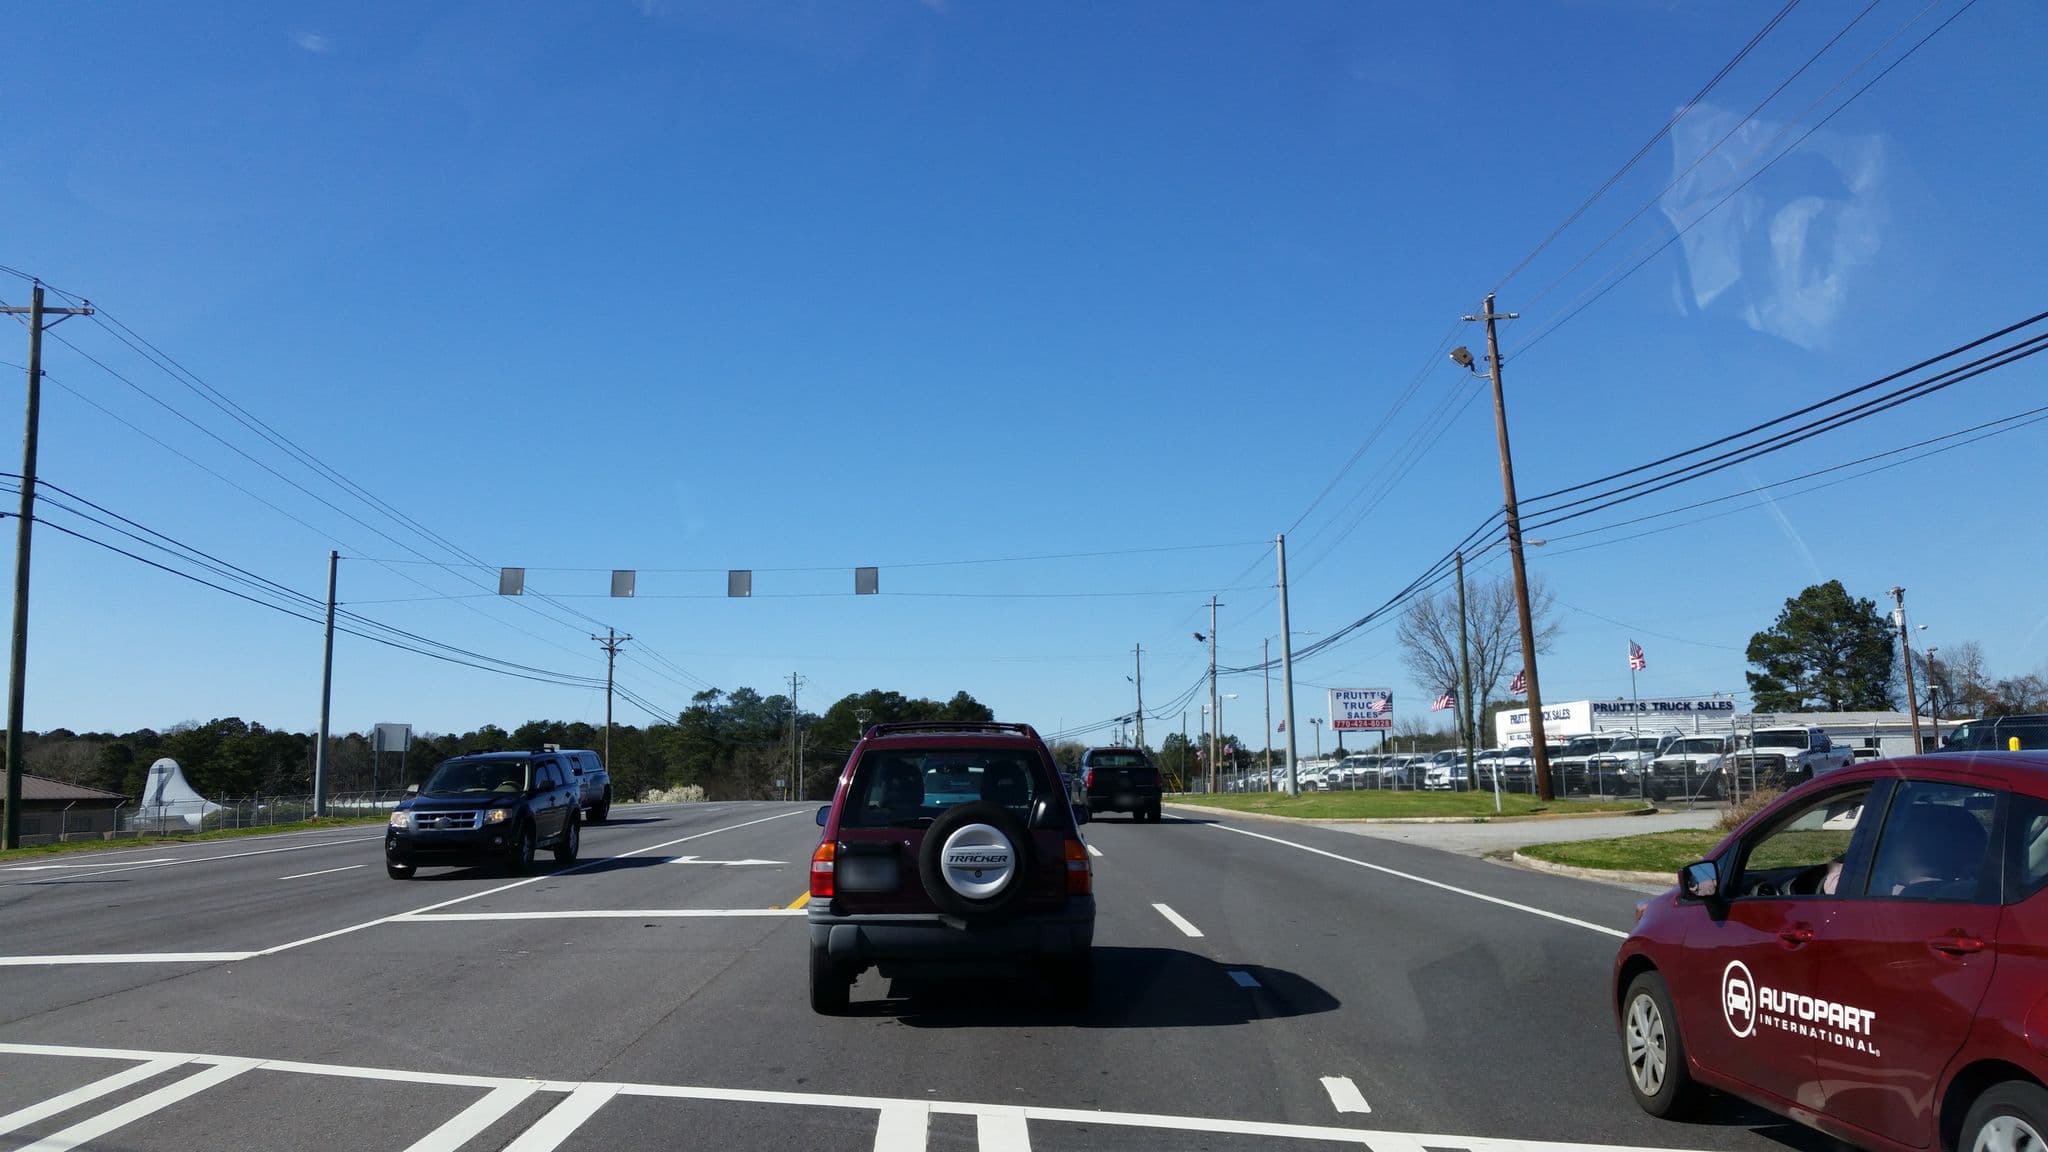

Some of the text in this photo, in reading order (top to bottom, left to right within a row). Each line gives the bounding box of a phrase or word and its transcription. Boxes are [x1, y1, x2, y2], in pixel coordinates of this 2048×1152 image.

[1336, 691, 1387, 700] PRUITT'S
[1343, 701, 1373, 710] TRUC
[1593, 700, 1733, 713] PRUITT'S TRUCK SALES
[1347, 711, 1378, 719] SALES
[1552, 708, 1571, 721] SALES
[949, 855, 1008, 863] TRACKER
[1759, 986, 1876, 1036] AUTOPART
[1759, 1013, 1877, 1055] INTERNATIONAL
